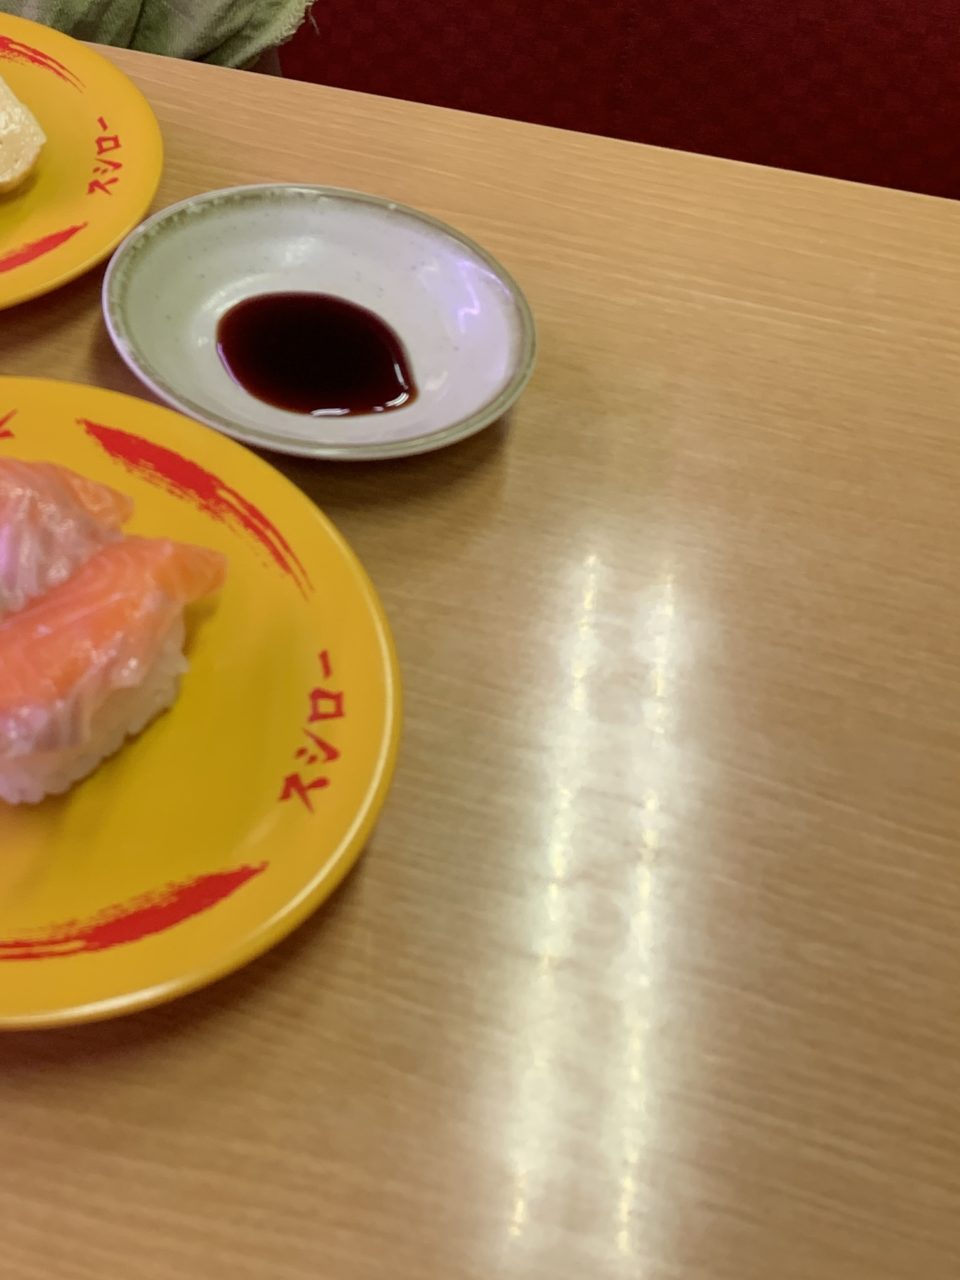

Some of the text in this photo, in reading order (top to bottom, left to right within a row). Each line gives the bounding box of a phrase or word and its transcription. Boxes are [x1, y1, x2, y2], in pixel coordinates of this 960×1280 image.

[86, 116, 123, 196] スシロー
[279, 649, 346, 812] スシロー
